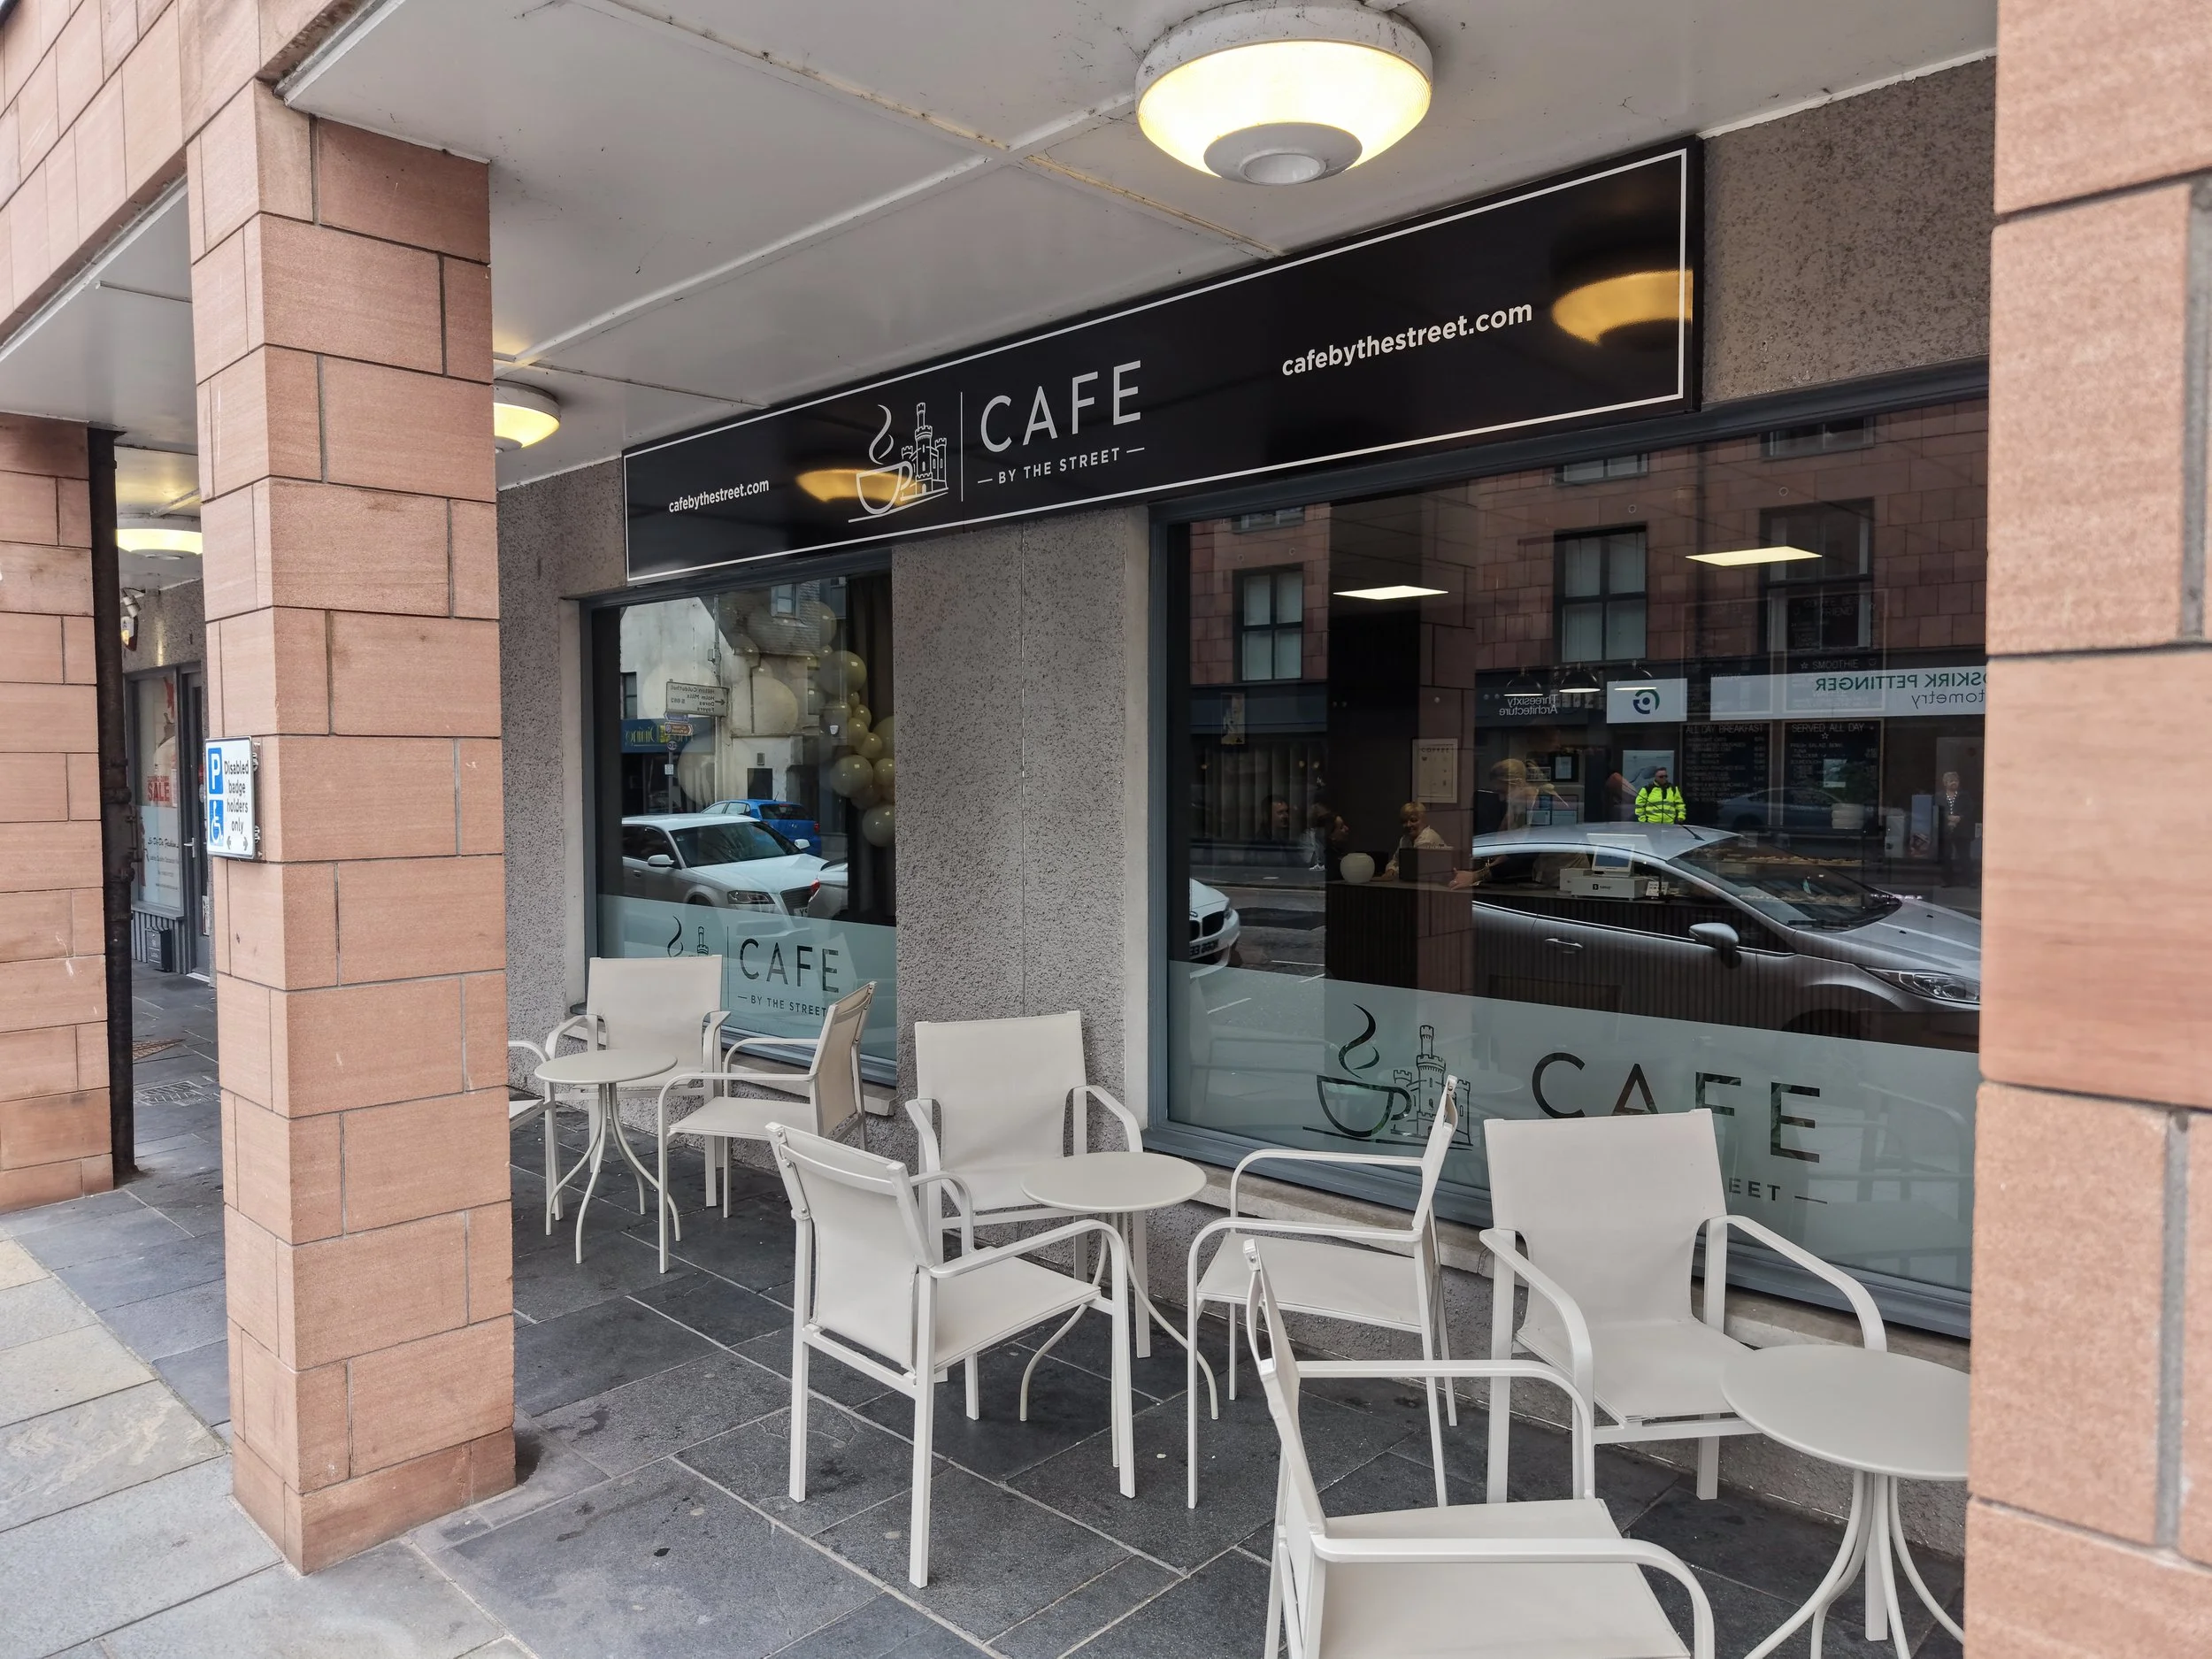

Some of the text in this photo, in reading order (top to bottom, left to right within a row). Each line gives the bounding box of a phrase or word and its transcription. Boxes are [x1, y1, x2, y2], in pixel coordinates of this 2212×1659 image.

[1281, 303, 1532, 376] cafebythestreet.com
[979, 359, 1142, 453] CAFE
[998, 448, 1120, 485] BY THE STREET
[668, 478, 770, 514] cafebythestreet.com
[1812, 659, 1859, 670] SMOOTHIE
[1718, 724, 1763, 733] BREAKFAST
[1791, 723, 1865, 733] SERVED ALL DAY
[211, 753, 220, 790] P
[224, 759, 249, 775] Disabled
[148, 782, 170, 802] SALE
[228, 780, 246, 796] badge
[227, 798, 249, 813] holders
[231, 817, 244, 834] only
[739, 938, 839, 994] CAFE
[751, 995, 827, 1018] BY THE STREET
[1532, 1052, 1821, 1164] CAFE
[1728, 1176, 1782, 1202] EET
